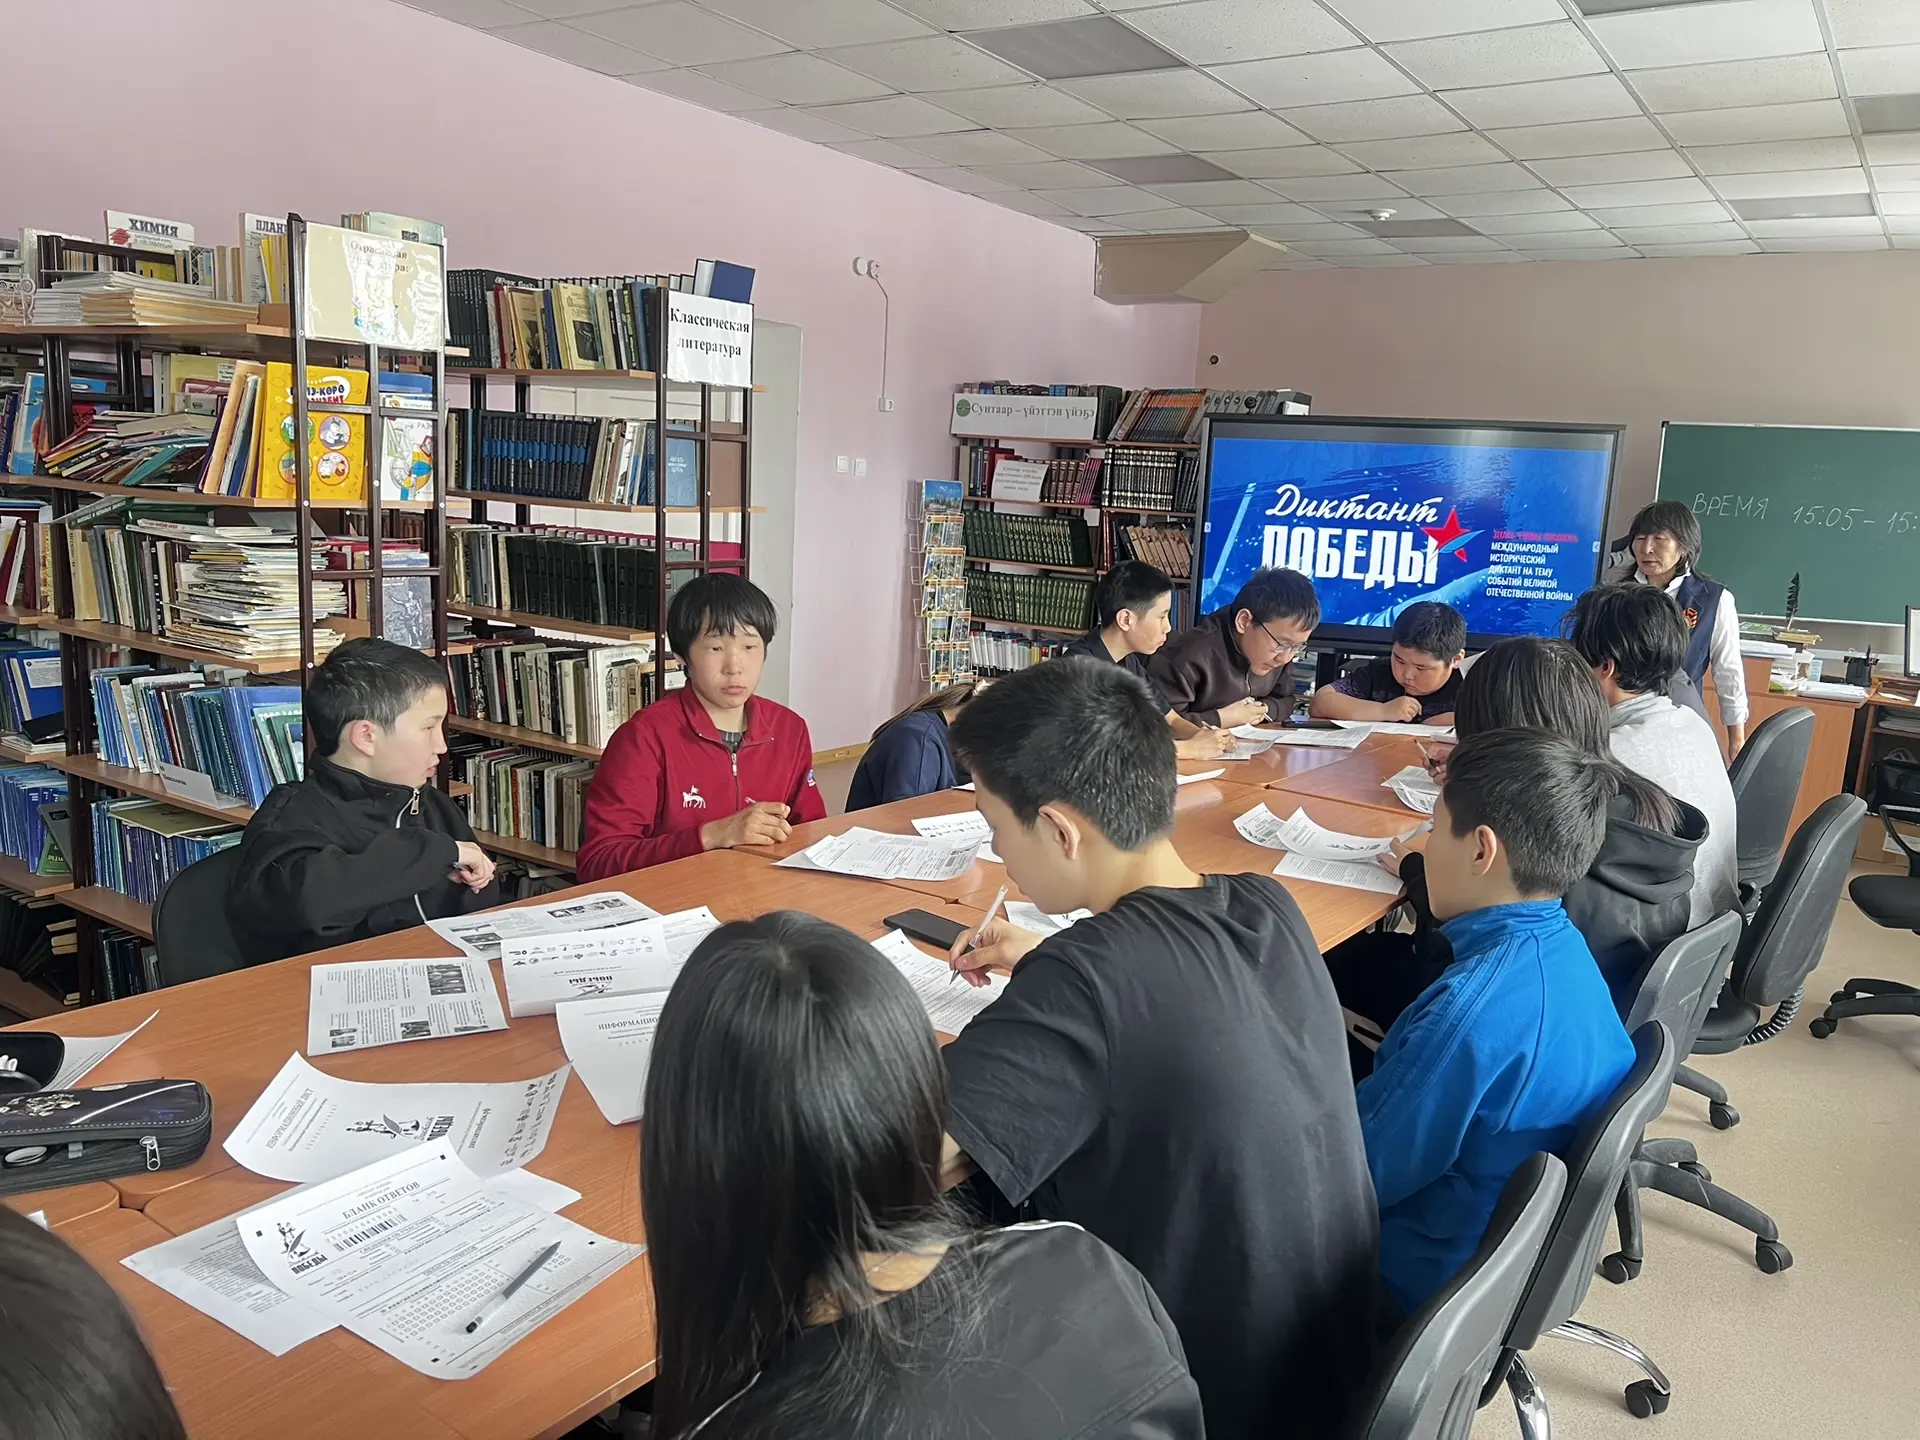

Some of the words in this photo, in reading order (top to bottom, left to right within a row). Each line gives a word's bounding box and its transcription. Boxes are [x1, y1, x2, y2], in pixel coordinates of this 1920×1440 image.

[128, 218, 178, 238] ХИМИЯ
[670, 307, 750, 334] Классическая
[677, 336, 742, 358] литература
[971, 402, 1013, 416] Сунтаар
[1265, 483, 1444, 524] Диктант
[1692, 492, 1769, 520] ВРЕМЯ
[1792, 505, 1864, 531] 15:05
[1262, 524, 1439, 590] ПОБЕДЫ
[1491, 541, 1559, 554] МЕЖДУНАРОДНЫЙ
[1489, 553, 1546, 565] ИСТОРИЧЕСКИЙ
[1488, 565, 1522, 575] ДИКТАНТ
[1522, 567, 1533, 576] НА
[1535, 568, 1553, 577] ТЕМУ
[1487, 576, 1522, 586] СОБЫТИЙ
[1523, 578, 1557, 588] ВЕЛИКОЙ
[1486, 587, 1544, 599] ОТЕЧЕСТВЕННОЙ
[1545, 591, 1573, 601] ВОЙНЫ
[342, 1198, 377, 1220] БЛАНК
[376, 1181, 421, 1205] ОТВЕТОВ
[291, 1254, 328, 1274] ПОБЕДЫ
